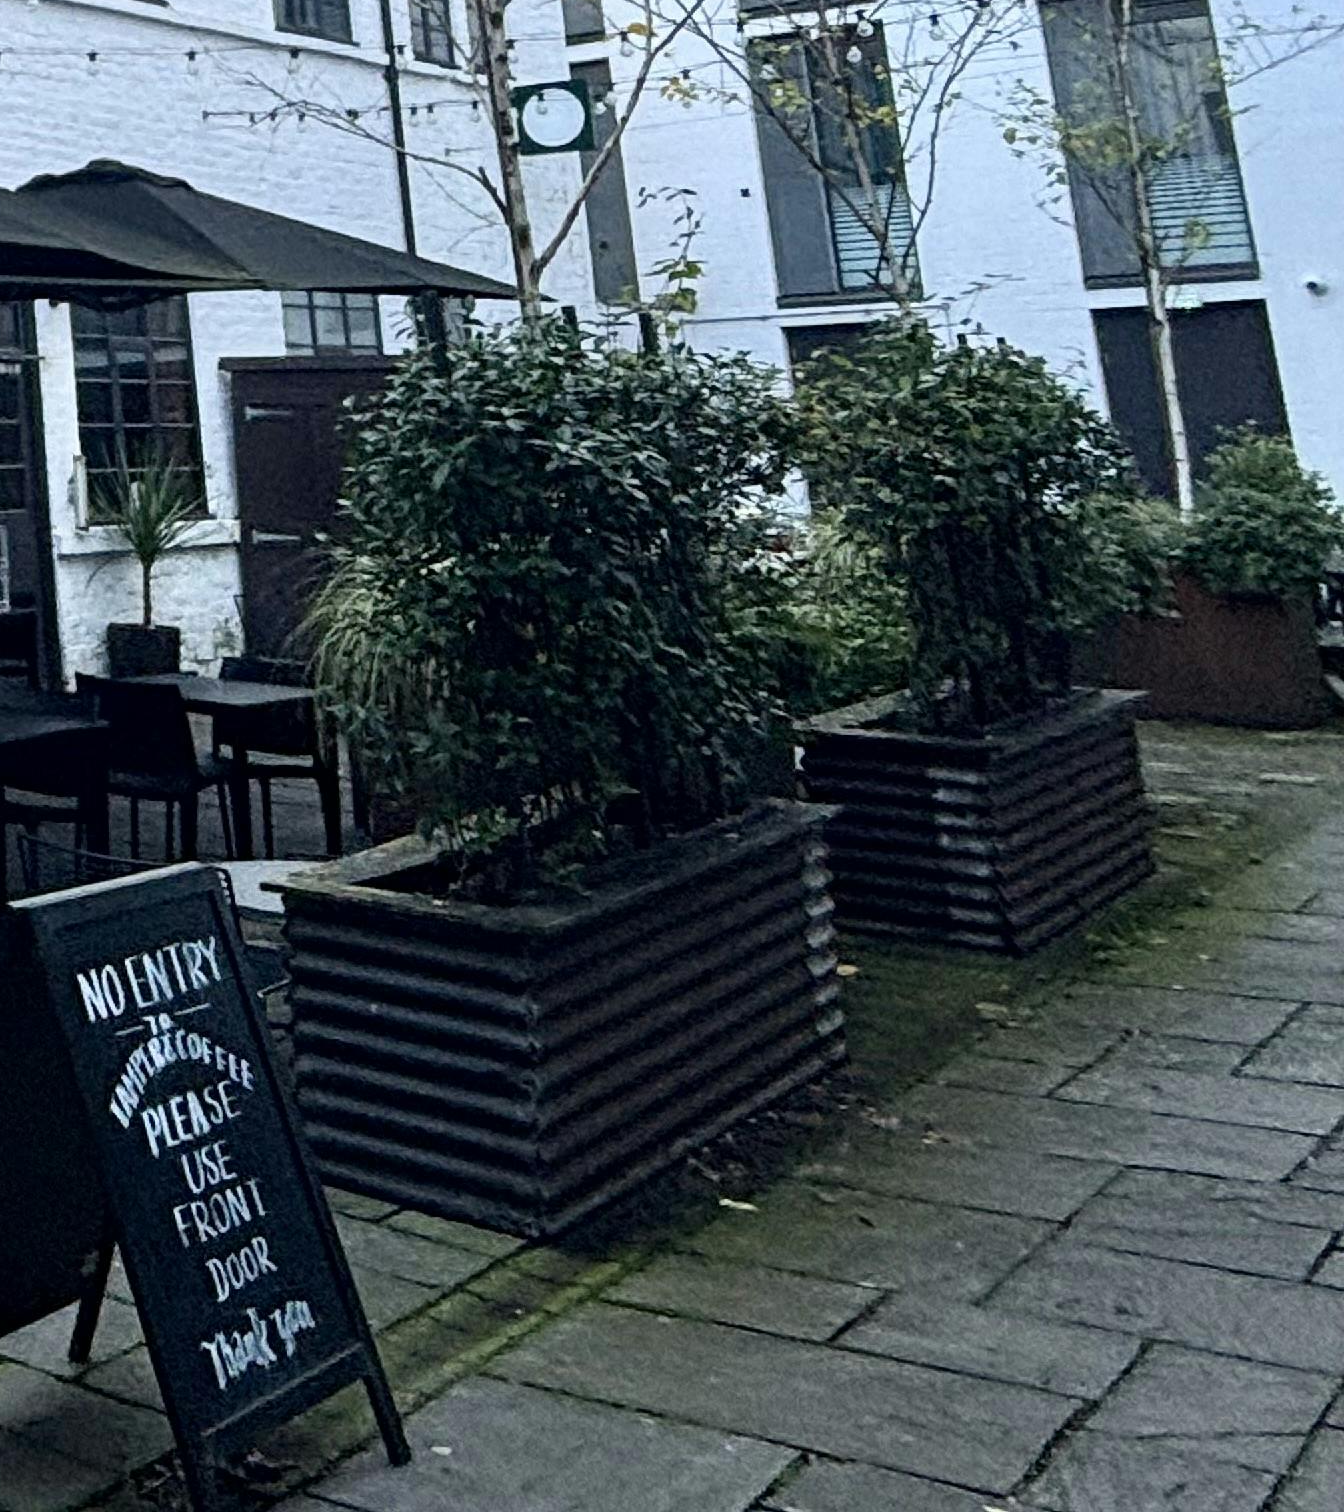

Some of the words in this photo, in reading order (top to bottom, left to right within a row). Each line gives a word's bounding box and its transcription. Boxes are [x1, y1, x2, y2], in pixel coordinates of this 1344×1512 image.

[76, 965, 126, 1023] NO
[125, 936, 221, 1008] ENTRY
[142, 1080, 242, 1159] PLEASE
[181, 1140, 238, 1194] USE
[173, 1178, 266, 1248] FRONT
[205, 1236, 279, 1303] DOOR
[200, 1307, 278, 1390] Thank
